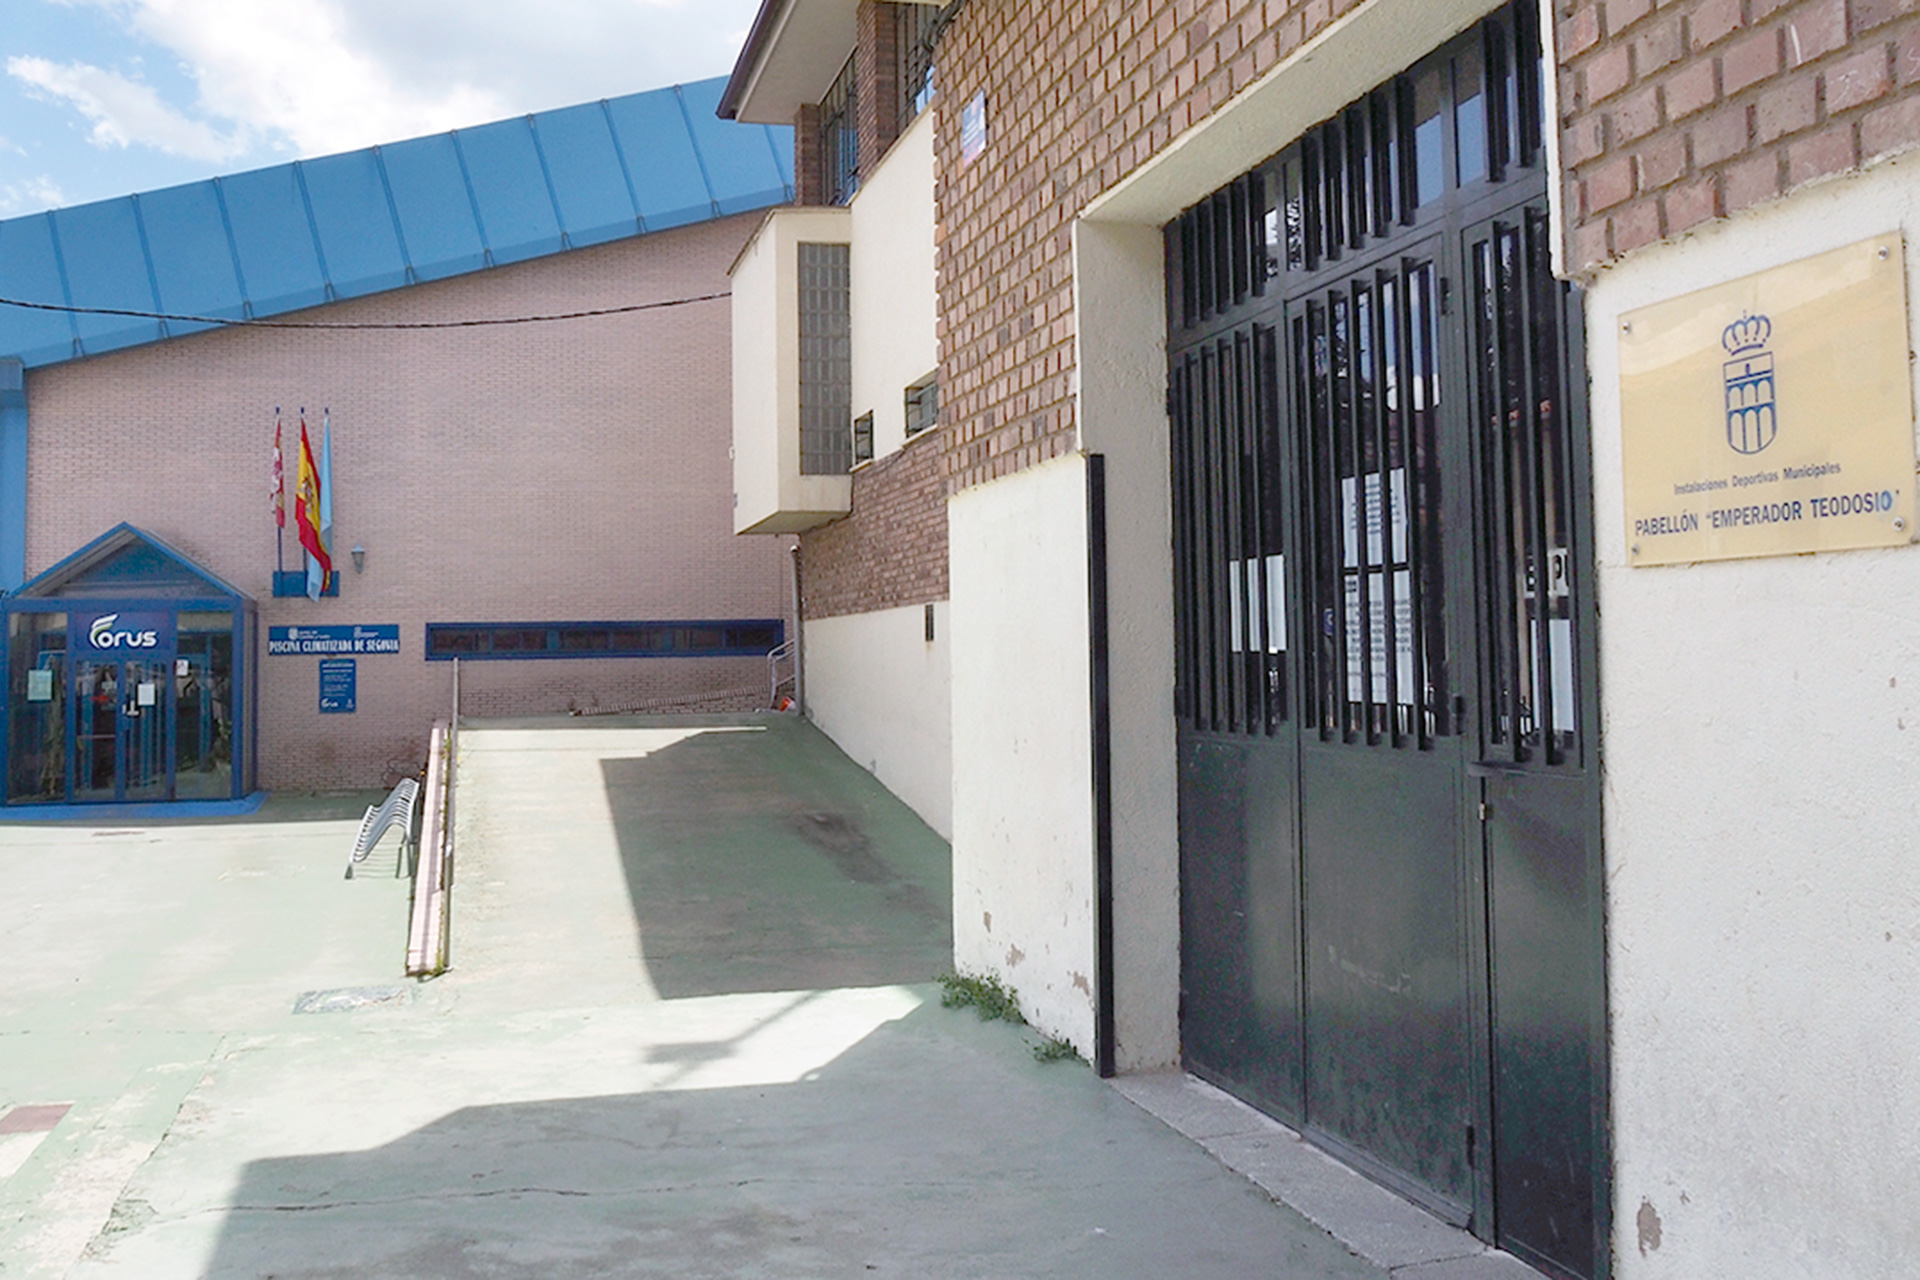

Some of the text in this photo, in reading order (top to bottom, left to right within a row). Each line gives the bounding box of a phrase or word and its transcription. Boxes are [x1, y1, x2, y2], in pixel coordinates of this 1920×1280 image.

[1674, 463, 1842, 495] Instalaciones Deportivas Municipales
[1635, 509, 1699, 537] PABELLÓN
[354, 639, 365, 651] DE
[366, 639, 399, 651] SEGOVIA
